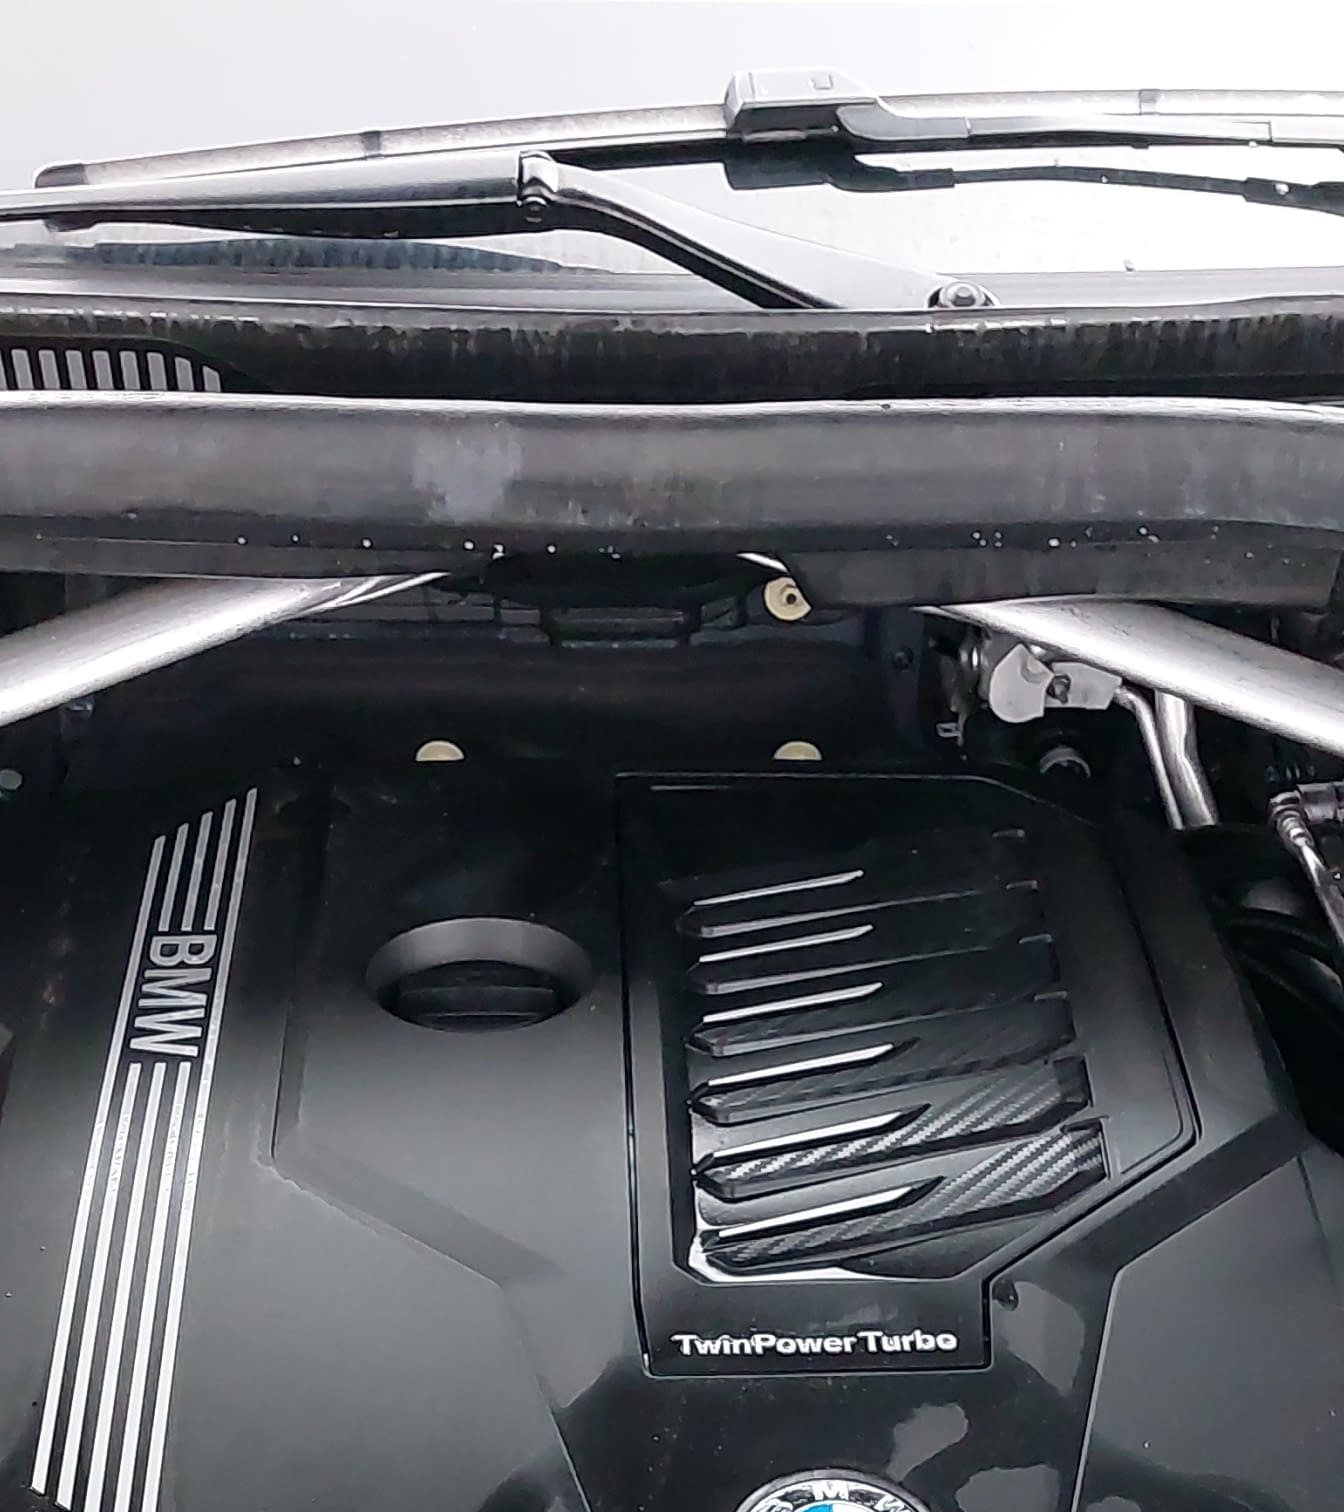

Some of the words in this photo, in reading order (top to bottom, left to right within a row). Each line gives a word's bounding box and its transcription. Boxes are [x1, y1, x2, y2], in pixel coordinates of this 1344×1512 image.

[129, 934, 217, 1057] BMW
[670, 1333, 856, 1355] TwinPower
[857, 1329, 958, 1352] Turbo
